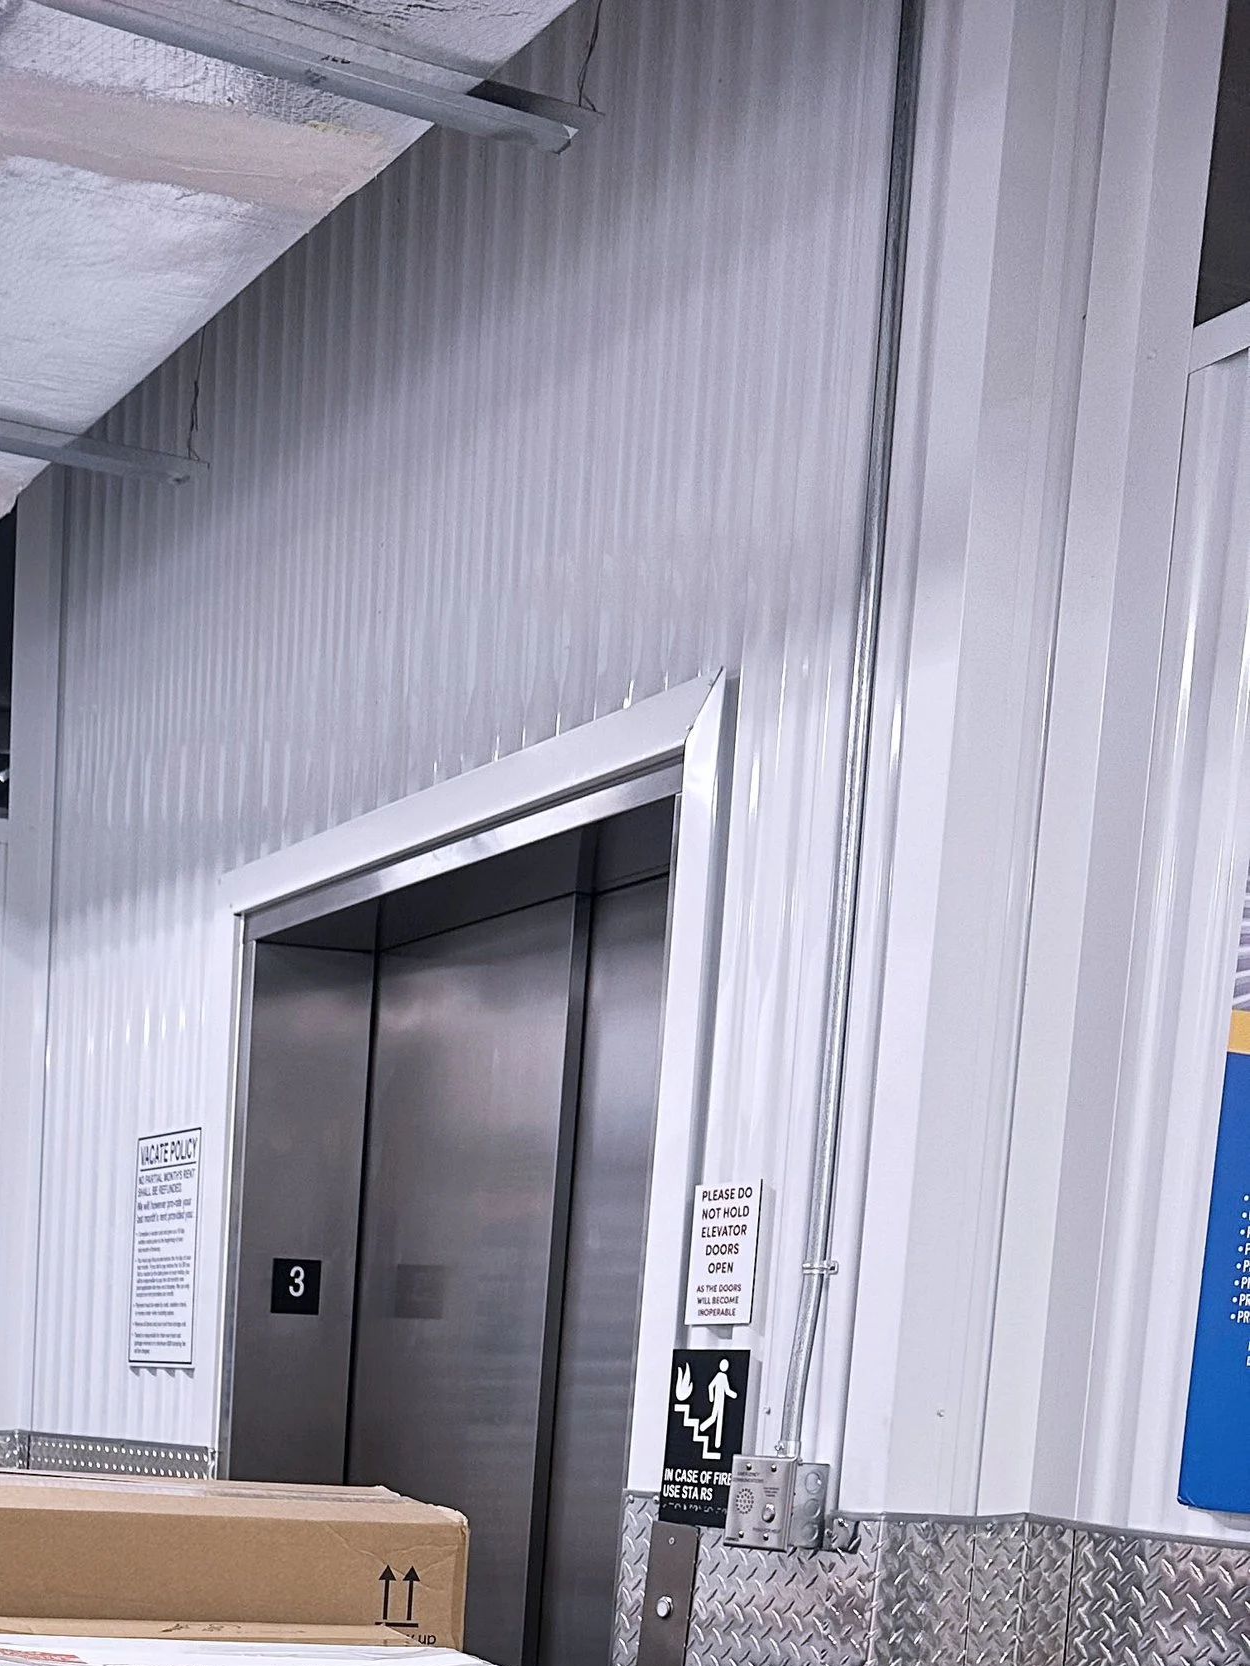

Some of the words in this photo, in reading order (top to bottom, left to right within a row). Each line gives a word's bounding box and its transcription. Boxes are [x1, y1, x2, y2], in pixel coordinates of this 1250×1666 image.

[140, 1142, 169, 1166] VACATE
[170, 1137, 198, 1162] POLICY
[702, 1188, 736, 1202] PLEASE
[737, 1187, 753, 1199] DO
[701, 1207, 721, 1221] NOT
[723, 1205, 750, 1219] HOLD
[701, 1224, 747, 1238] ELEVATOR
[705, 1243, 739, 1256] DOORS
[707, 1262, 734, 1274] OPEN
[289, 1265, 305, 1297] 3
[696, 1285, 704, 1293] AS
[706, 1284, 718, 1292] THE
[718, 1284, 742, 1292] DOORS
[697, 1297, 711, 1305] WILL
[712, 1296, 739, 1304] BECOME
[697, 1308, 736, 1317] INOPERABLE
[664, 1468, 674, 1481] IN
[675, 1468, 699, 1484] CASE
[699, 1470, 713, 1485] OF
[713, 1471, 732, 1486] FIRE
[662, 1484, 681, 1498] USE
[418, 1635, 436, 1645] up
